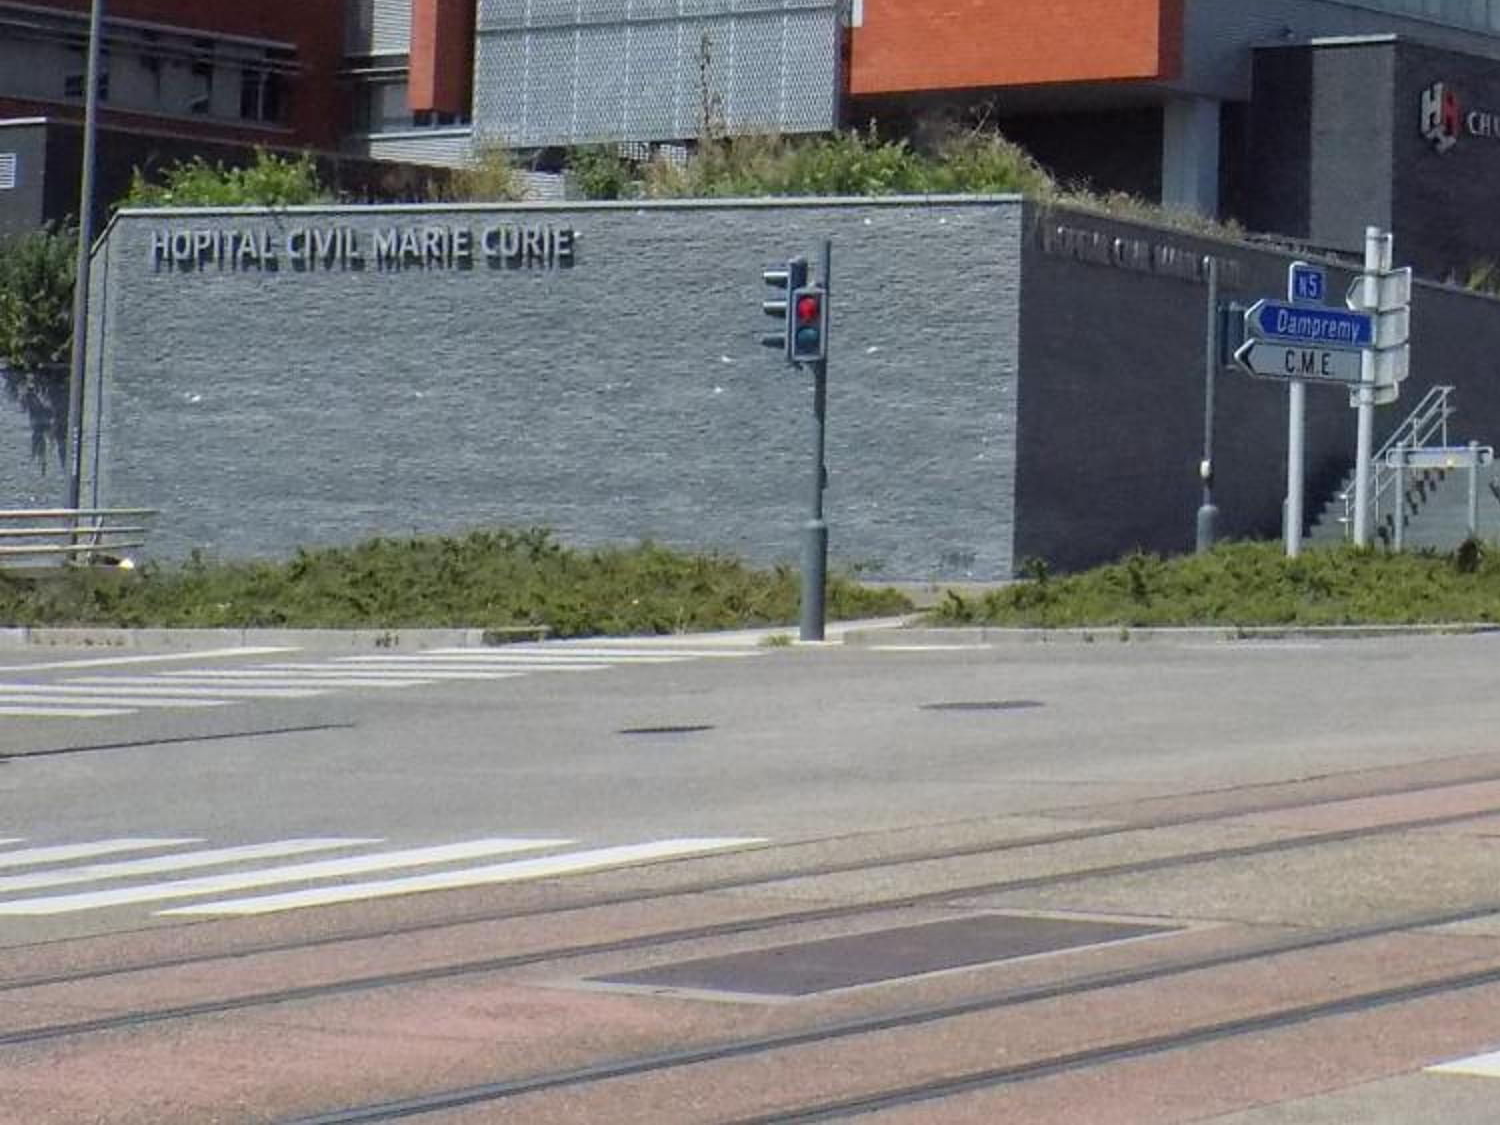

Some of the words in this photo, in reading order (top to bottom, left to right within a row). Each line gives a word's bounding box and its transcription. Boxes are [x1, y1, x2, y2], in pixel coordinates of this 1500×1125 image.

[151, 228, 275, 262] HOPITAL
[287, 227, 359, 260] CIVIL
[373, 226, 470, 258] MARIE
[481, 224, 572, 257] CURIE
[1277, 308, 1361, 346] Dampremy
